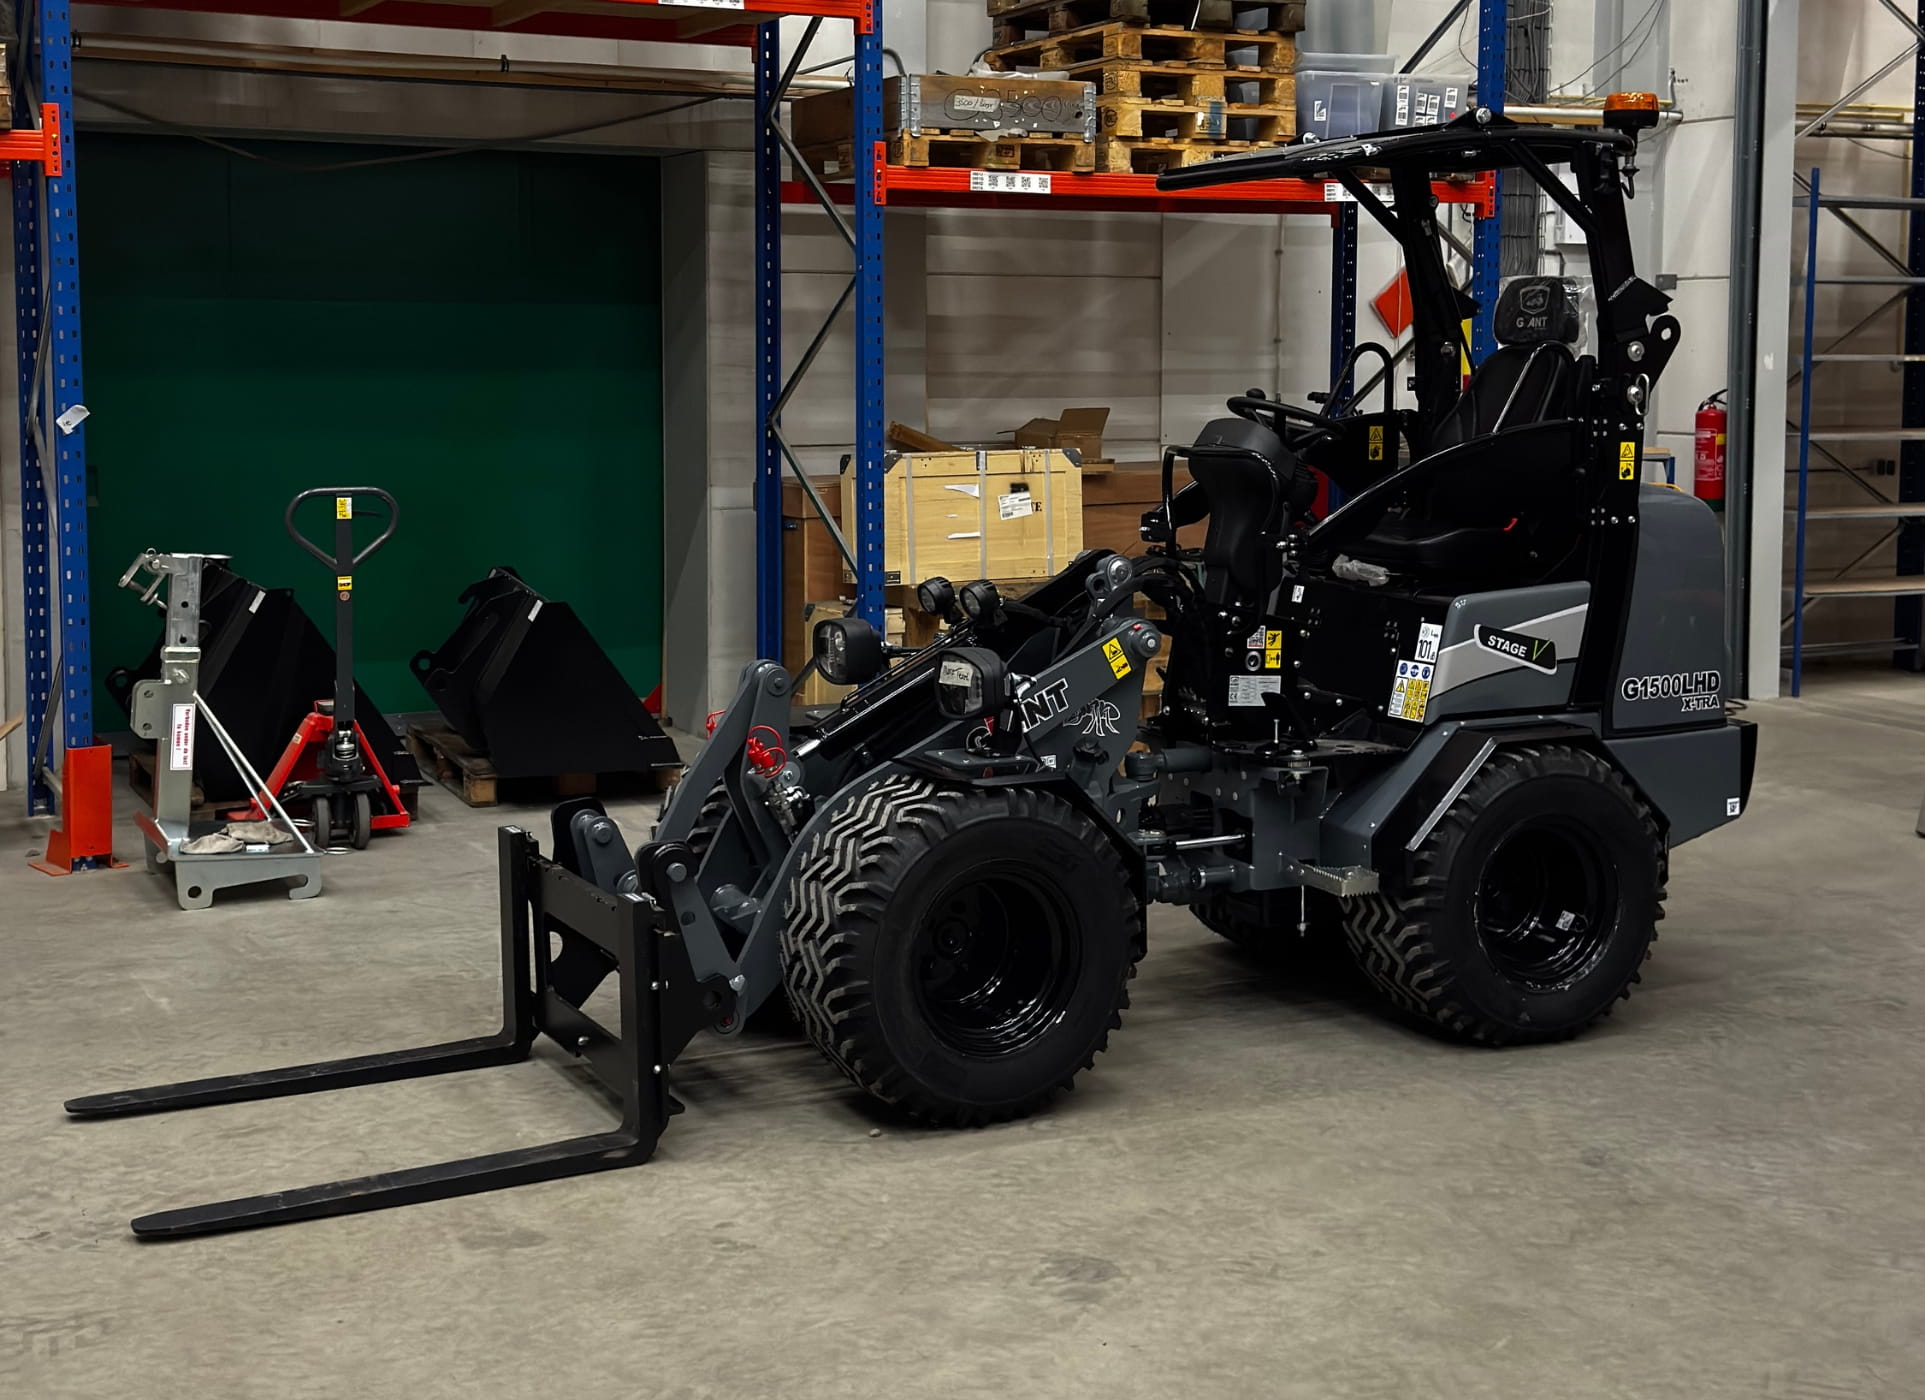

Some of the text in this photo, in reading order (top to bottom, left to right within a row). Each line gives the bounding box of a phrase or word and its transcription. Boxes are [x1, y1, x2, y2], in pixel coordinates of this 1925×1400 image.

[1417, 639, 1433, 660] 101
[1487, 635, 1551, 661] STAGE V
[1621, 670, 1721, 702] G1500LHD
[1680, 694, 1720, 712] X-TRA
